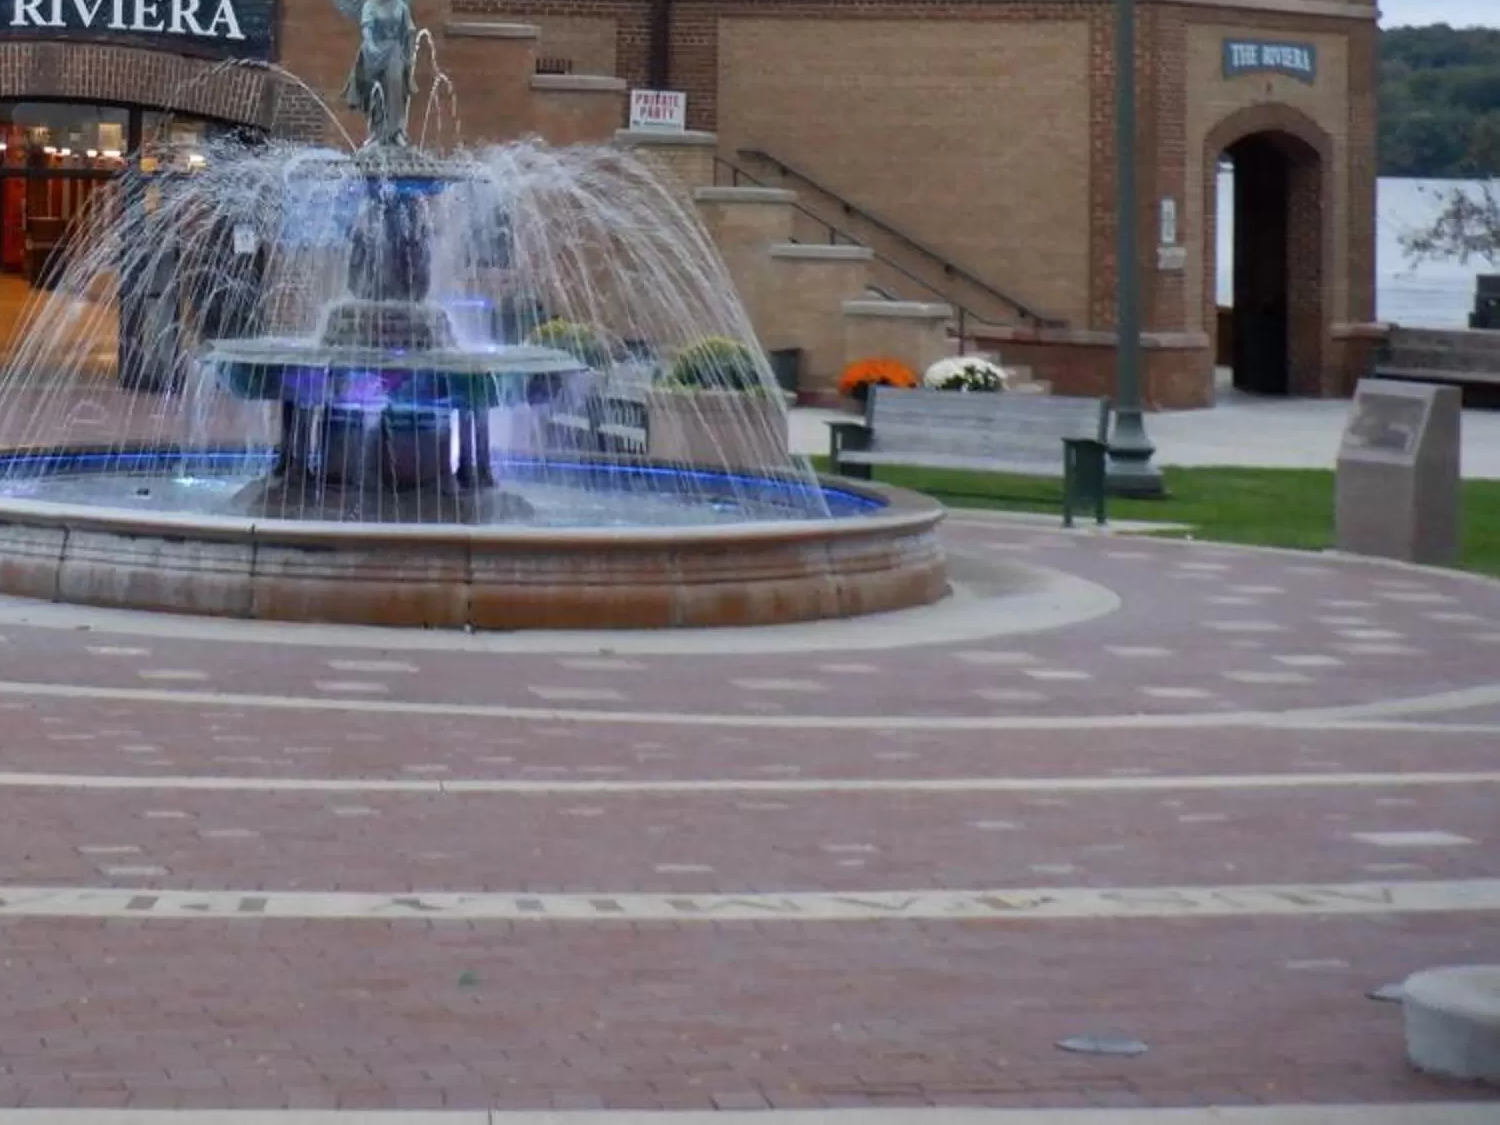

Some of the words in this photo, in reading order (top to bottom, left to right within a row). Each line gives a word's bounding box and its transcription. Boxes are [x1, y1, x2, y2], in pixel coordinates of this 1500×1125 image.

[1229, 43, 1259, 67] THE
[1262, 44, 1310, 72] RIVIERA
[635, 93, 679, 108] PRIVATE
[639, 105, 675, 120] PARTY
